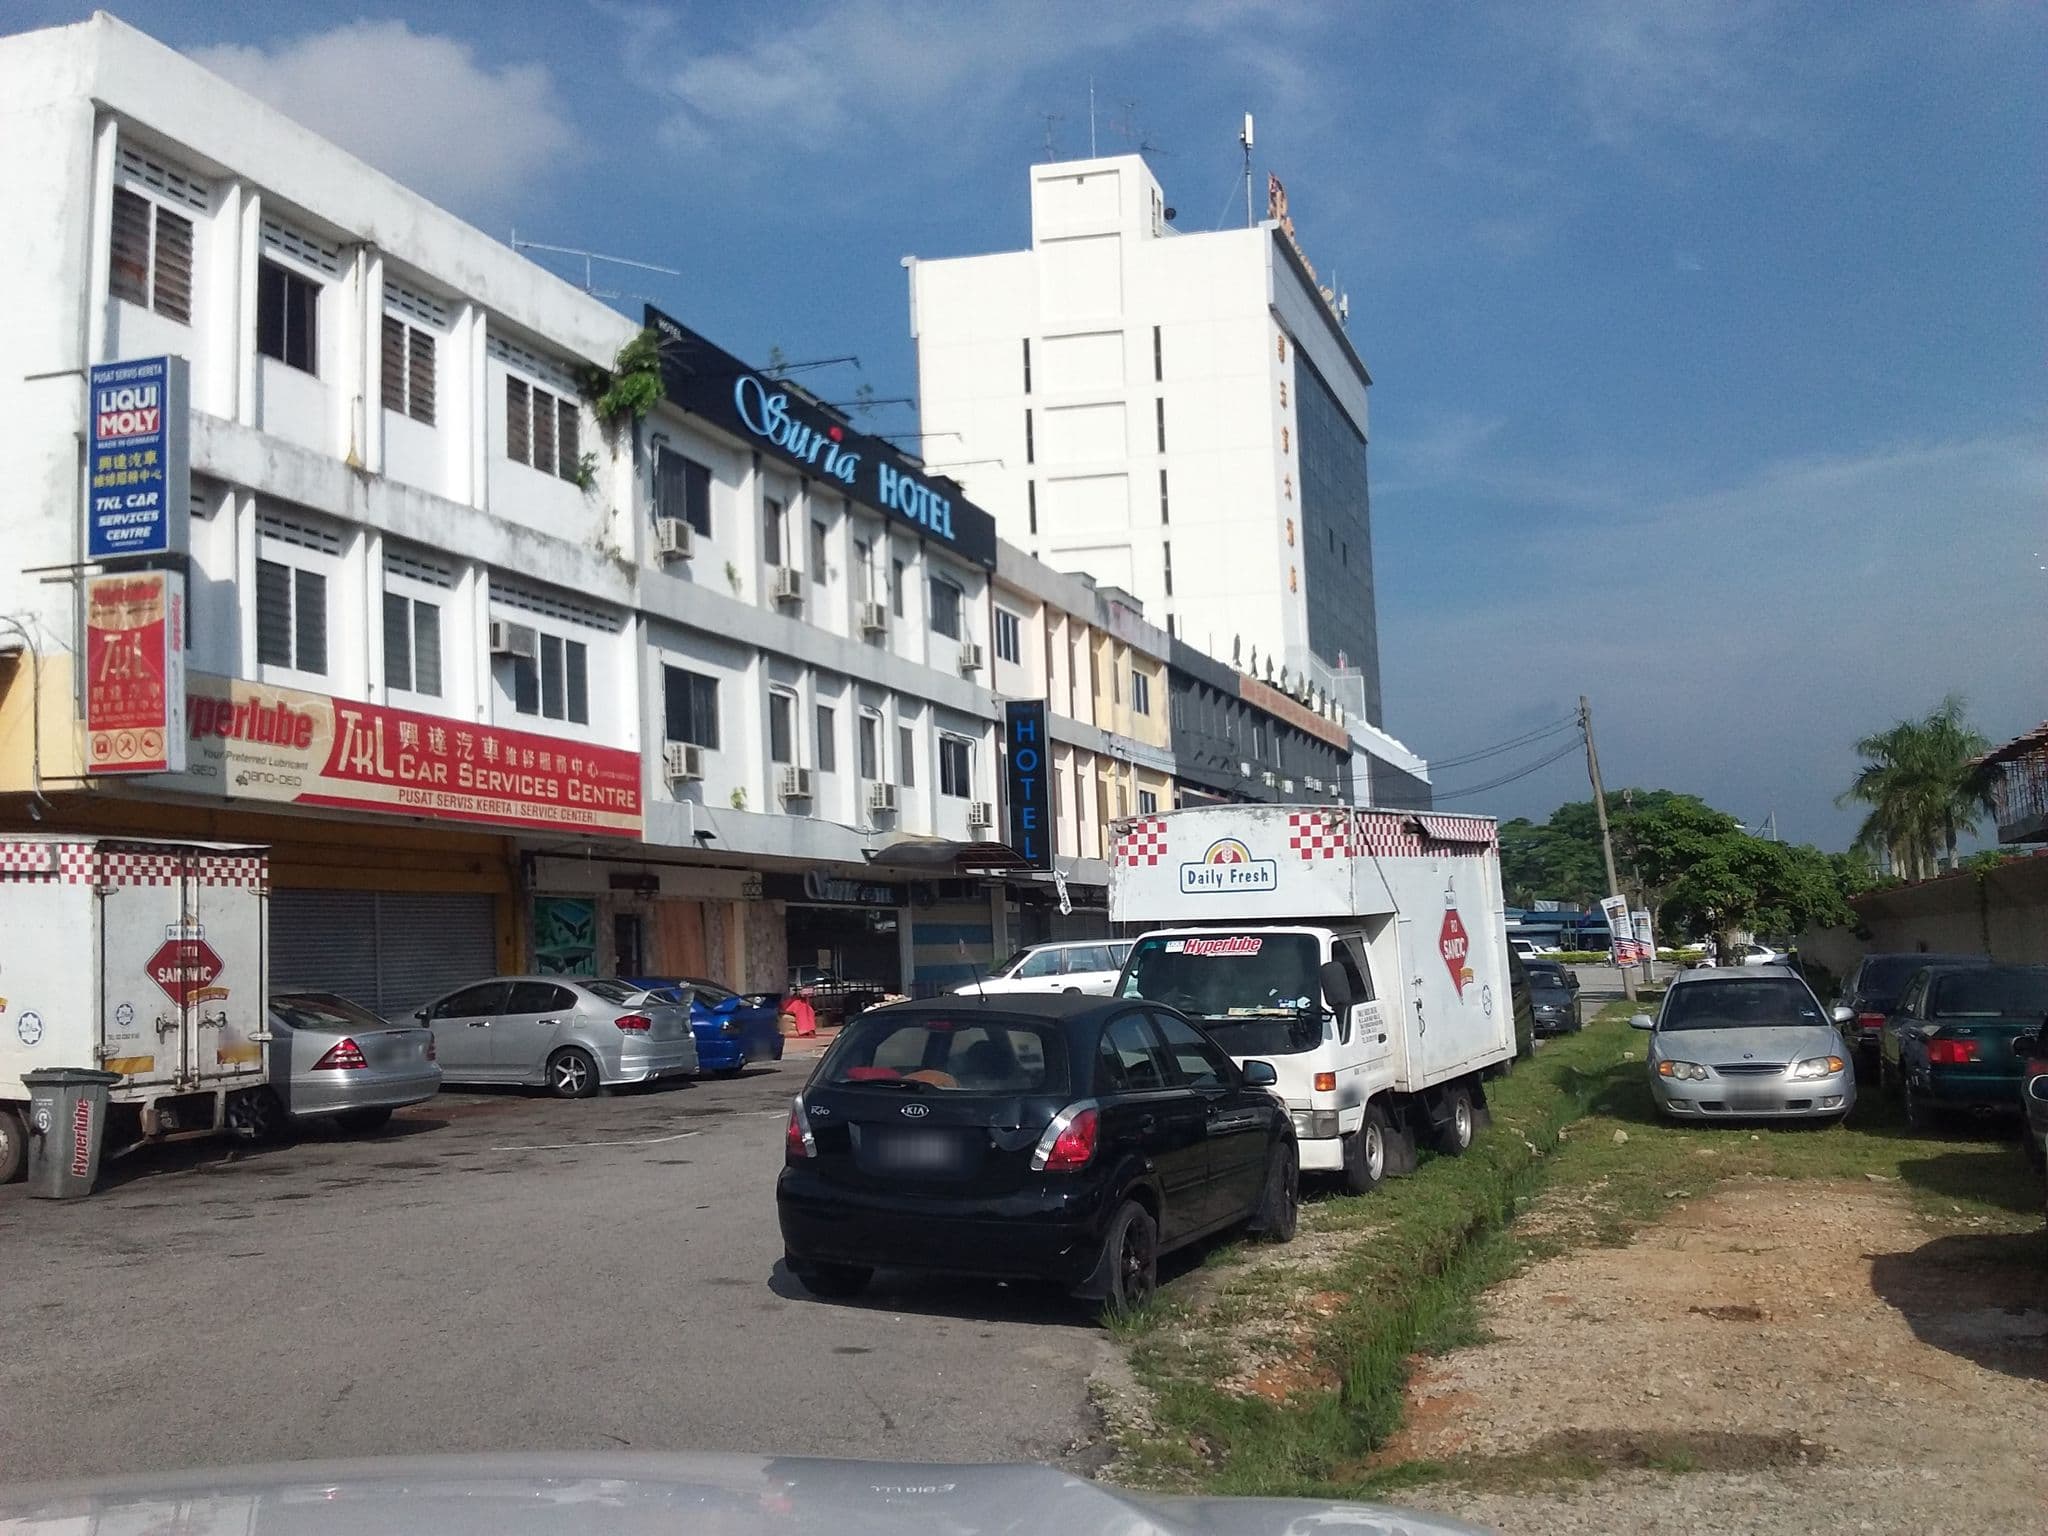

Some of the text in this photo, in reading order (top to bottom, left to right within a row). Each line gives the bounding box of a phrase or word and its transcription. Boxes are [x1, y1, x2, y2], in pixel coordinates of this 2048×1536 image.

[100, 386, 157, 413] LIQUI
[100, 409, 158, 436] MOLY
[735, 375, 955, 540] Suria HOTEL
[96, 492, 159, 512] TKL CAR
[98, 510, 160, 527] SERVICES
[105, 527, 152, 542] CENTRE
[187, 694, 313, 750] perlube
[338, 709, 637, 809] TKL CAR SERVICES CENTRE
[1016, 719, 1038, 859] HOTEL
[399, 789, 593, 824] PUSAT SERVIS KERETA SERVICE CENTER
[1188, 867, 1268, 888] Daily Fresh
[1185, 937, 1262, 956] Hyperlube
[811, 1105, 830, 1115] Rio
[905, 1107, 924, 1115] KIA
[72, 1098, 90, 1177] Hyperlube
